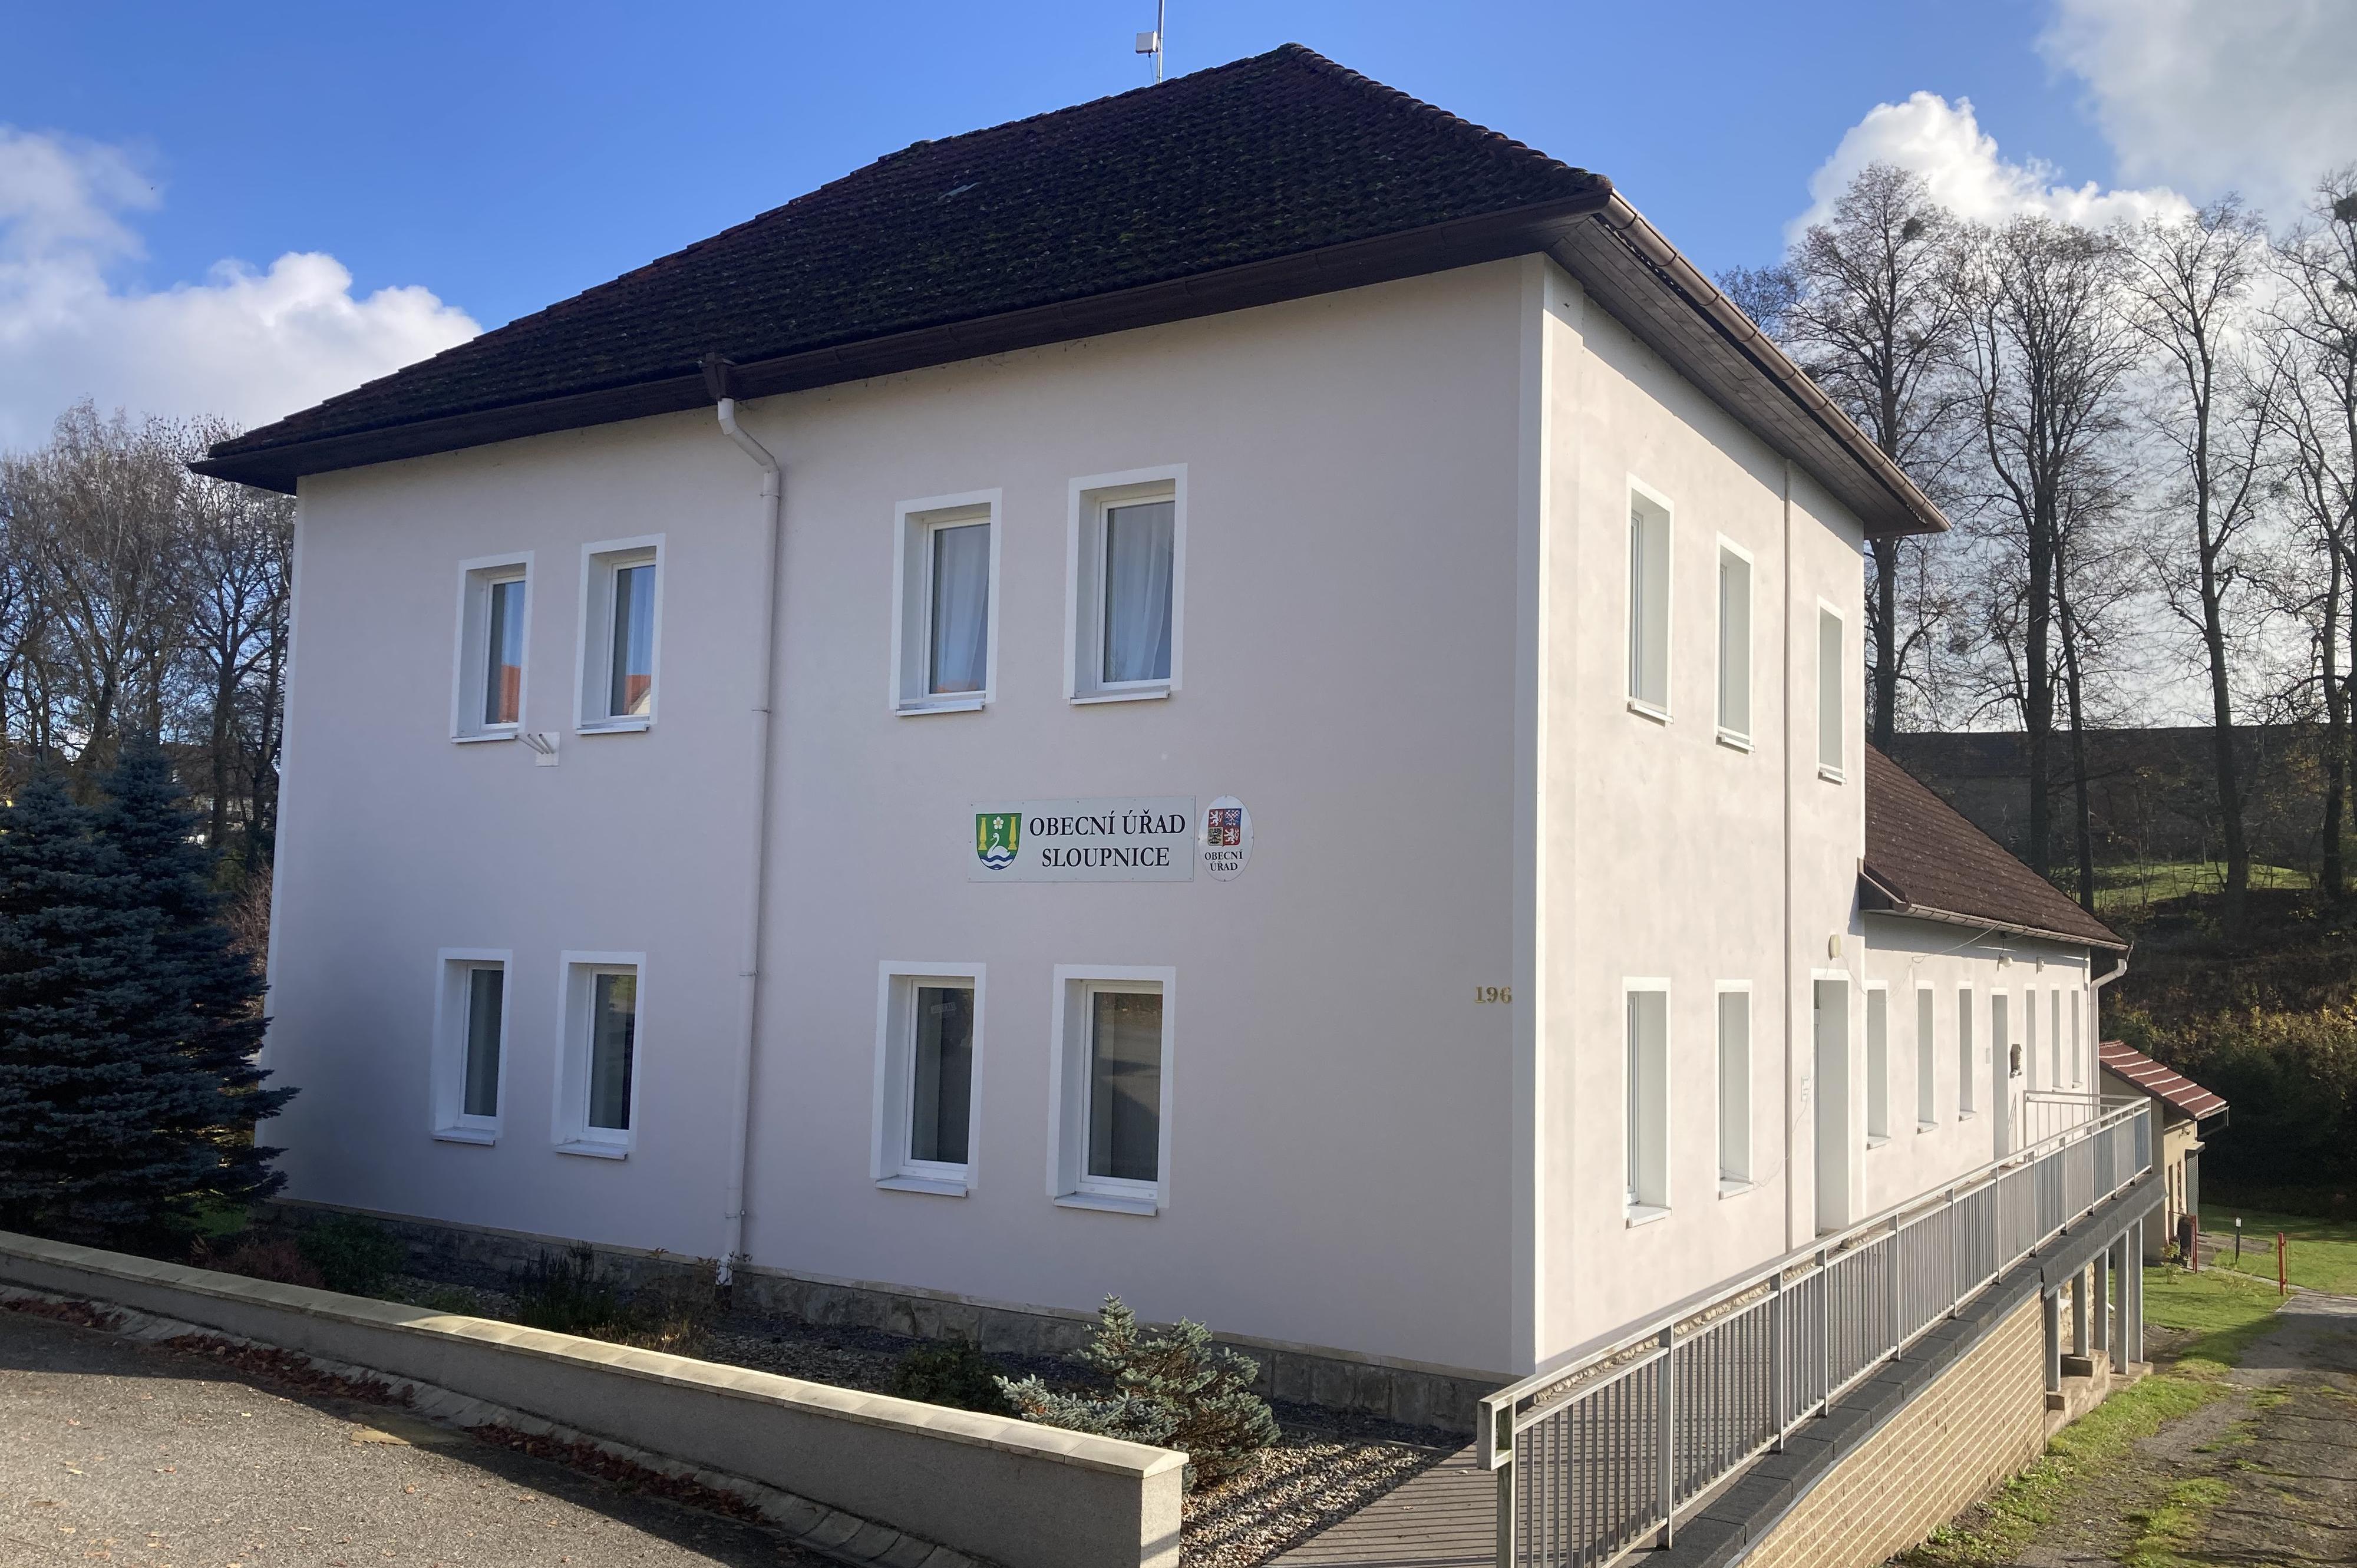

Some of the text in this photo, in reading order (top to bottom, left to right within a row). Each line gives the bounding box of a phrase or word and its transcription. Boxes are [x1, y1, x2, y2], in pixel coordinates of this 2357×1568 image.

[1029, 808, 1186, 836] OBECNÍ ÚŘAD
[1042, 847, 1170, 867] SLOUPNICE
[1204, 849, 1243, 860] OBECNÍ
[1210, 861, 1238, 872] ÚŘAD
[1475, 986, 1512, 1003] 196
